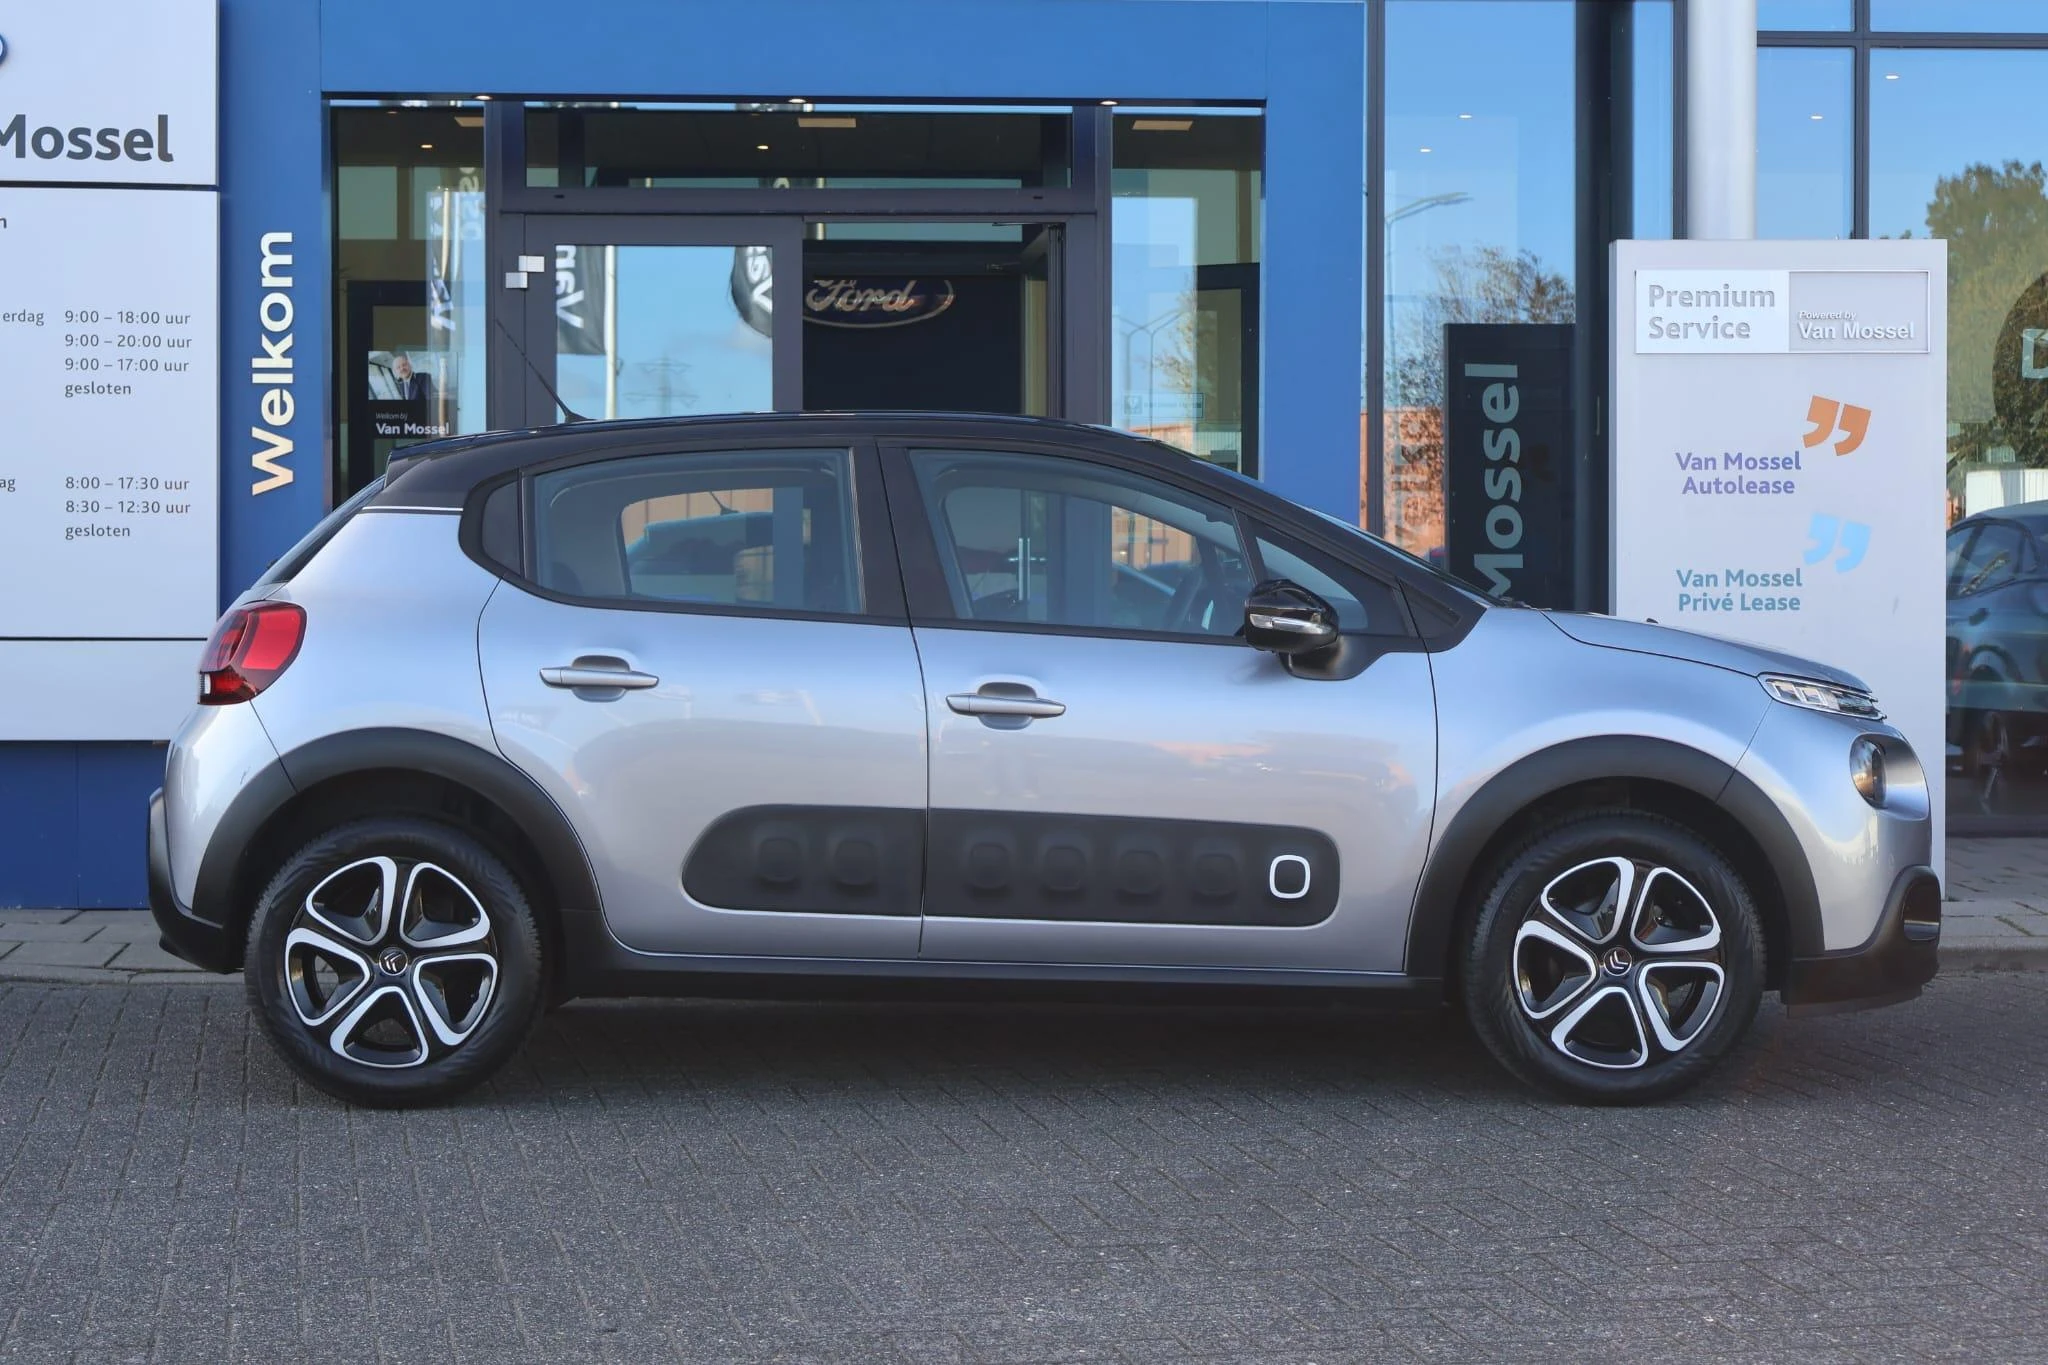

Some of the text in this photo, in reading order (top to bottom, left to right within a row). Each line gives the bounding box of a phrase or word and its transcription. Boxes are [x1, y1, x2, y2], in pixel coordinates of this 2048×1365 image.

[805, 279, 916, 312] Ford
[1648, 283, 1776, 308] Premium
[64, 310, 100, 324] 9:00
[117, 311, 160, 325] 18:00
[165, 314, 191, 325] uur
[1798, 310, 1858, 322] Powered by
[1648, 315, 1751, 340] Service
[1798, 321, 1915, 340] Van Mossel
[64, 334, 100, 347] 9:00
[117, 334, 162, 348] 20:00
[167, 338, 193, 349] uur
[64, 357, 100, 371] 9:00
[117, 358, 159, 372] 17:00
[164, 361, 190, 372] uur
[251, 231, 295, 496] Welkom
[64, 381, 132, 398] gesloten
[375, 421, 449, 435] Van Mossel
[1675, 451, 1802, 471] Van Mossel
[65, 476, 101, 490] 8:00
[118, 477, 159, 490] 17:30
[164, 480, 190, 491] uur
[1681, 475, 1796, 495] Autolease
[65, 500, 100, 513] 8:30
[118, 501, 161, 514] 12:30
[165, 503, 191, 514] uur
[65, 523, 131, 541] gesloten
[1676, 567, 1803, 588] Van Mossel
[1678, 592, 1801, 612] Privé Lease
